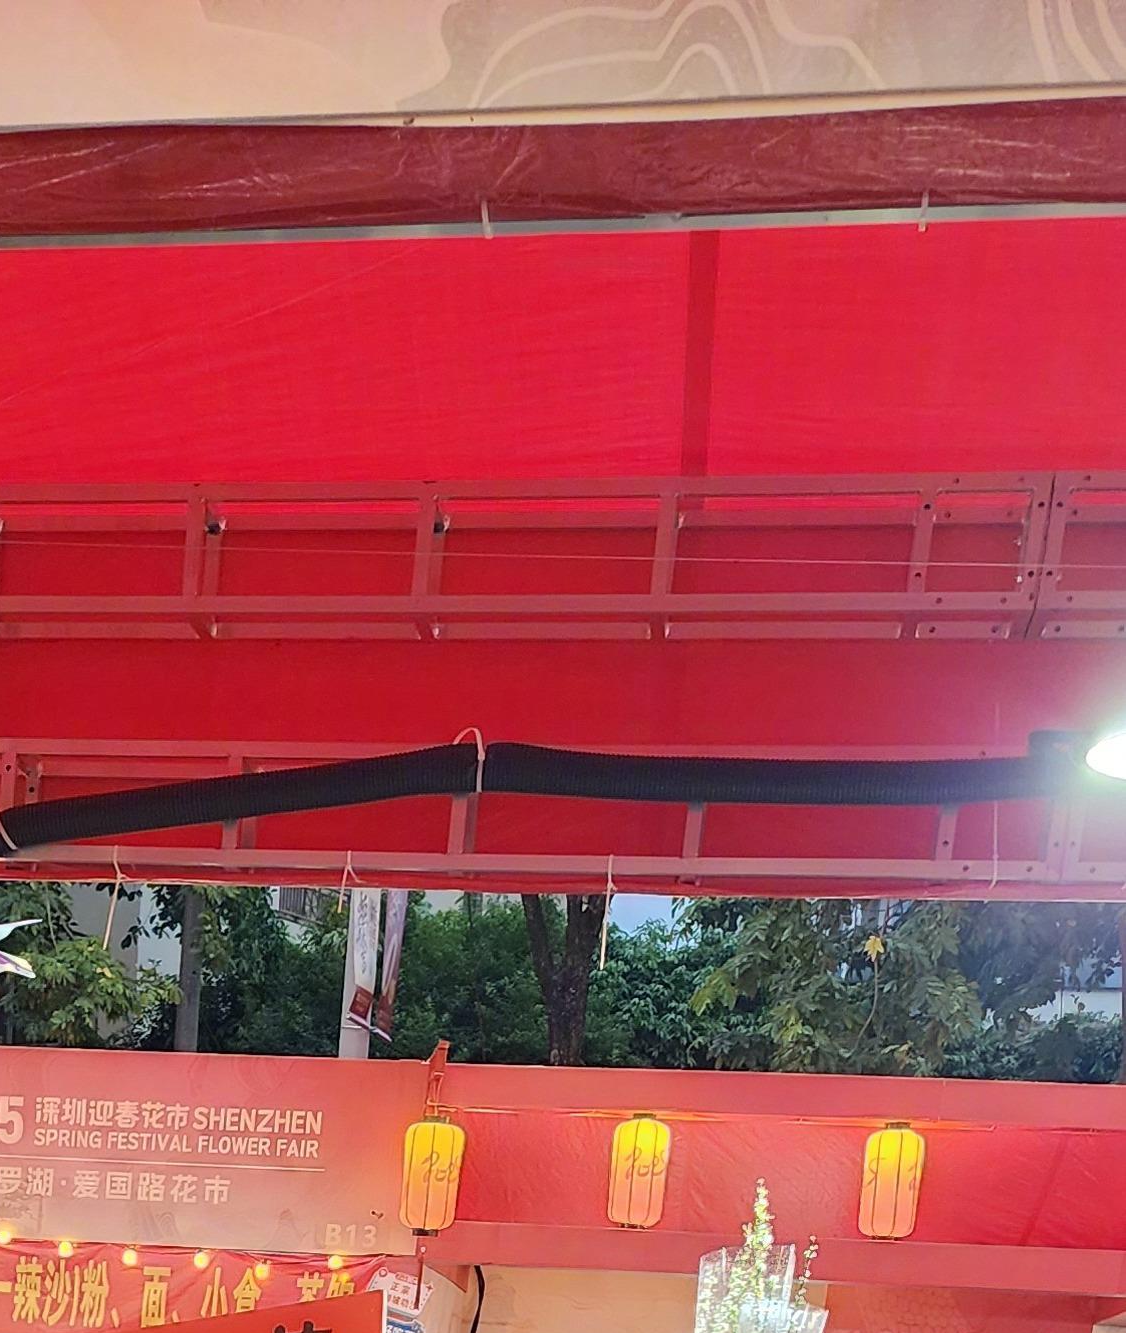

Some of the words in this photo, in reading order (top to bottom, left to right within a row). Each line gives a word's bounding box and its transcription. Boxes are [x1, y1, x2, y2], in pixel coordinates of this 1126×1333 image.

[34, 1097, 190, 1131] 深圳迎春花市
[193, 1106, 323, 1135] SHENZHEN
[34, 1128, 102, 1149] SPRING
[106, 1132, 192, 1152] FESTIVAL
[197, 1135, 271, 1156] FLOWER
[276, 1138, 319, 1158] FAIR
[324, 1223, 377, 1247] B13
